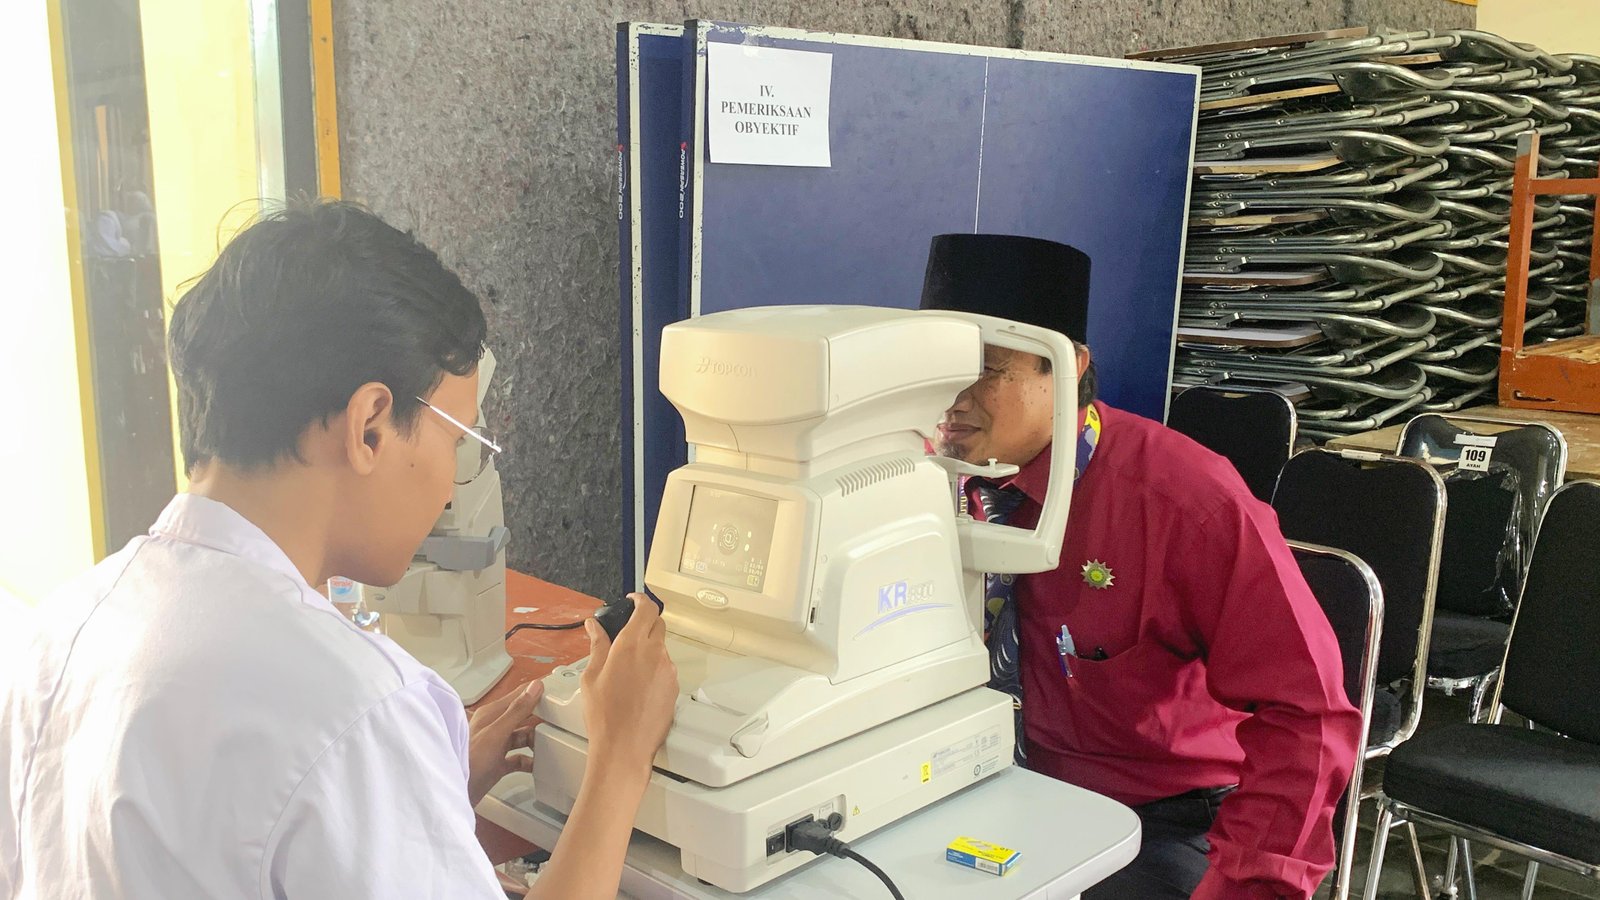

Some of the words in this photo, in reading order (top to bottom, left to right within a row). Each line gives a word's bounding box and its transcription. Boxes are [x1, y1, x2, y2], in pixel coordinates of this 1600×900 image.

[760, 84, 774, 98] IV.
[721, 100, 811, 118] PEMERIKSAAN
[735, 121, 799, 136] OBYEKTIF
[1465, 449, 1487, 462] 109
